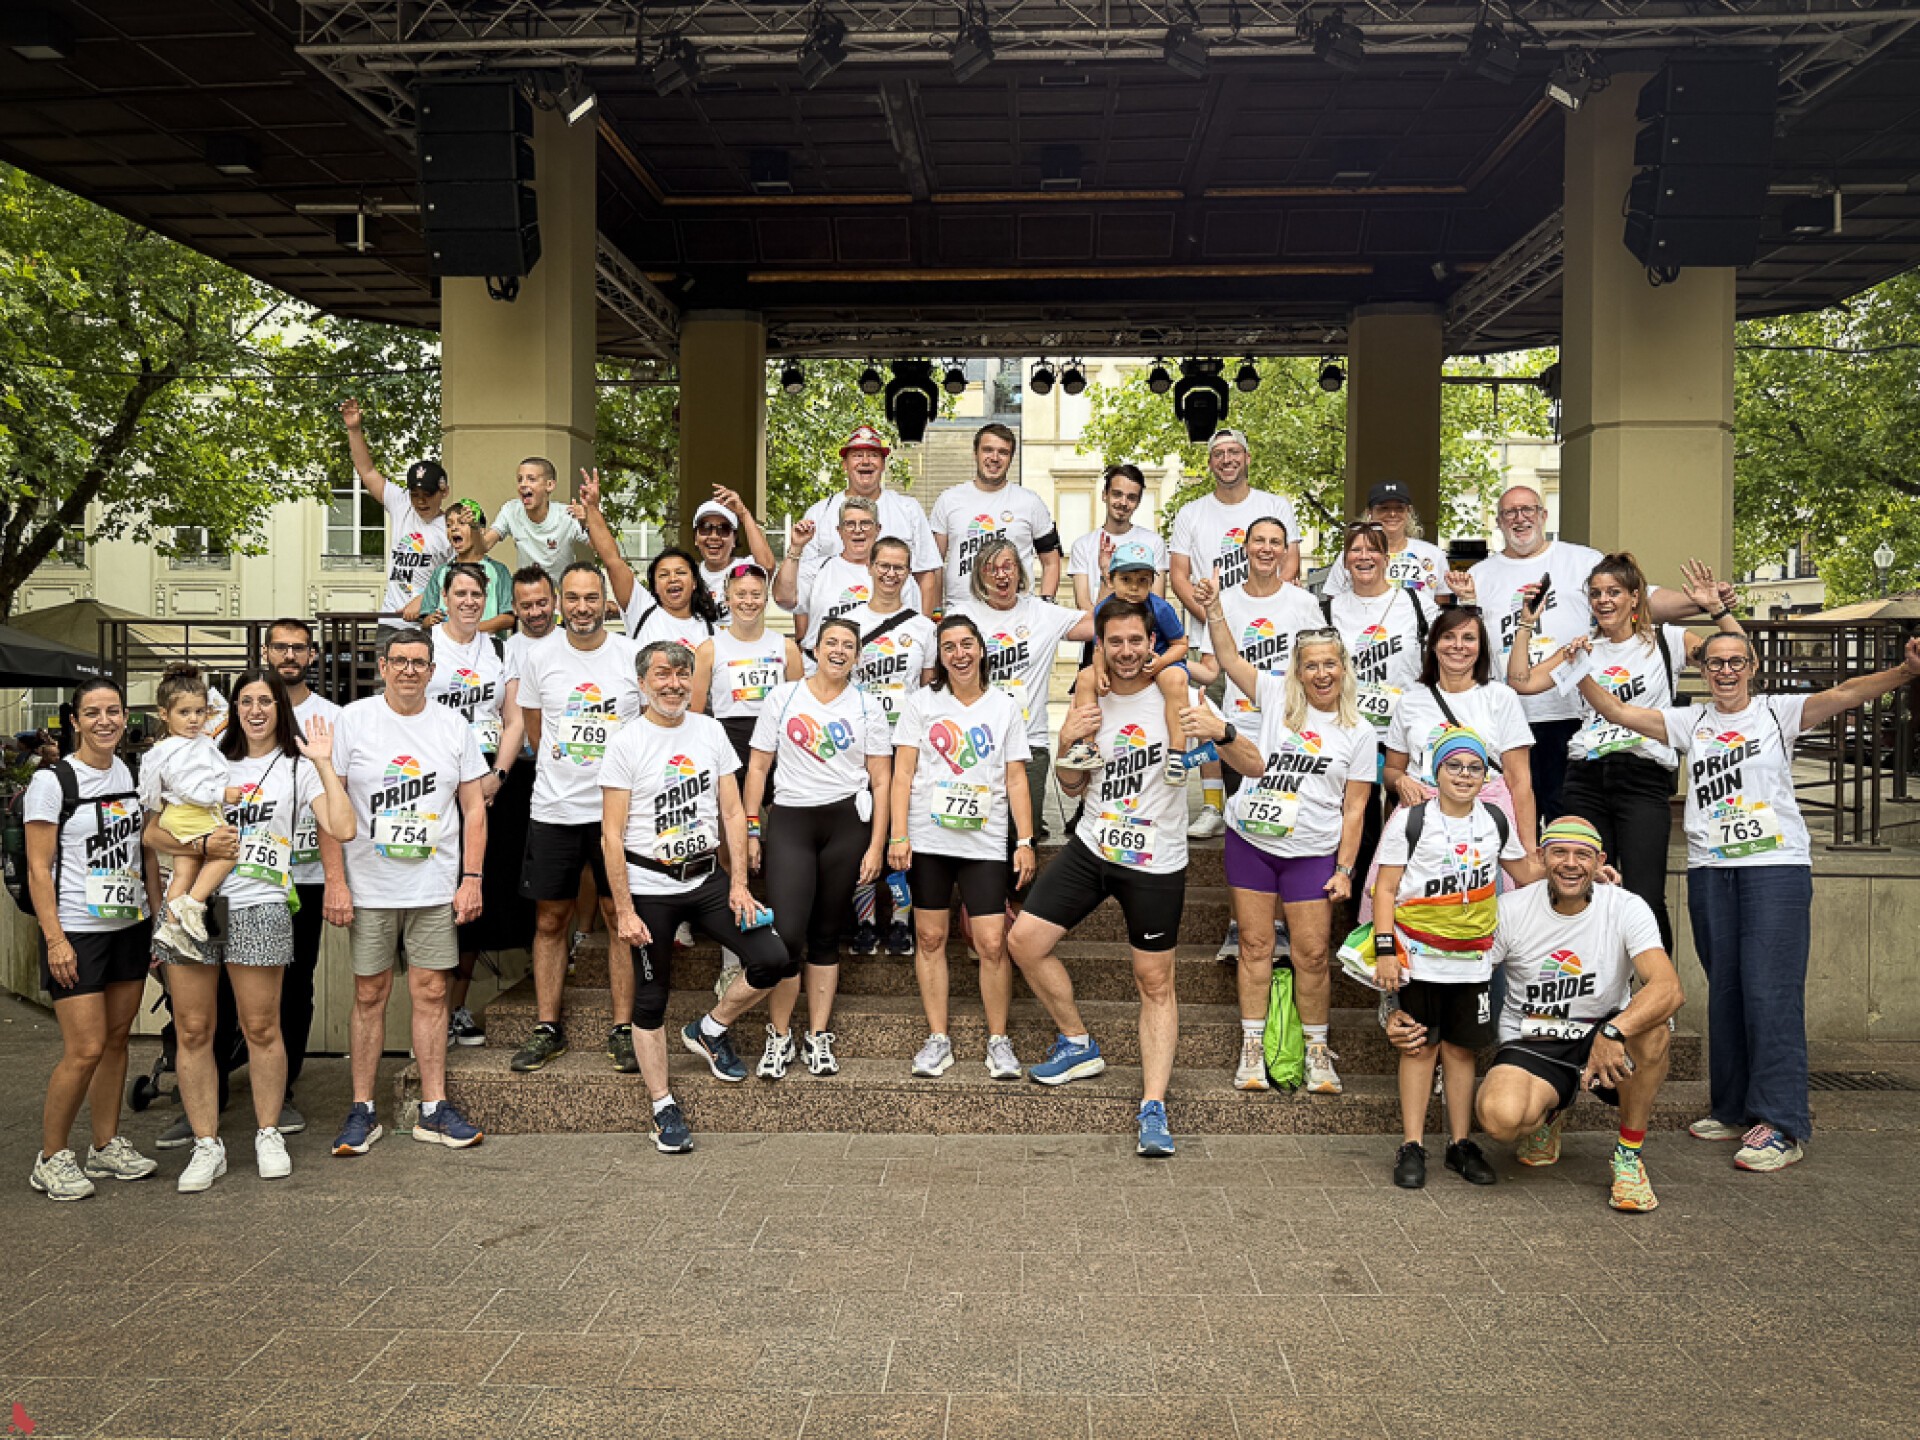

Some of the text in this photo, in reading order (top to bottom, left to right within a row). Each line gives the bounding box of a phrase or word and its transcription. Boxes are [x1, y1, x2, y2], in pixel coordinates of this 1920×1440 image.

[988, 641, 1030, 671] RIDE
[737, 670, 779, 687] 1671
[1357, 694, 1389, 714] 749
[571, 725, 607, 743] 769
[1105, 742, 1162, 780] PRIDE
[1265, 752, 1333, 775] PRIDE
[1693, 739, 1761, 785] PRIDE
[370, 771, 437, 815] PRIDE
[655, 769, 711, 815] PRIDE
[1101, 773, 1143, 802] RUN
[1257, 774, 1304, 793] RUN
[1696, 768, 1743, 810] RUN
[946, 796, 978, 816] 775
[1248, 802, 1282, 823] 752
[655, 801, 698, 835] RUN
[86, 810, 142, 860] PRIDE
[296, 831, 318, 850] 76
[391, 825, 428, 845] 754
[1100, 827, 1146, 850] 1669
[1720, 820, 1763, 844] 763
[245, 844, 277, 867] 756
[661, 834, 708, 859] 1668
[102, 884, 136, 905] 764
[1526, 972, 1596, 1003] PRIDE
